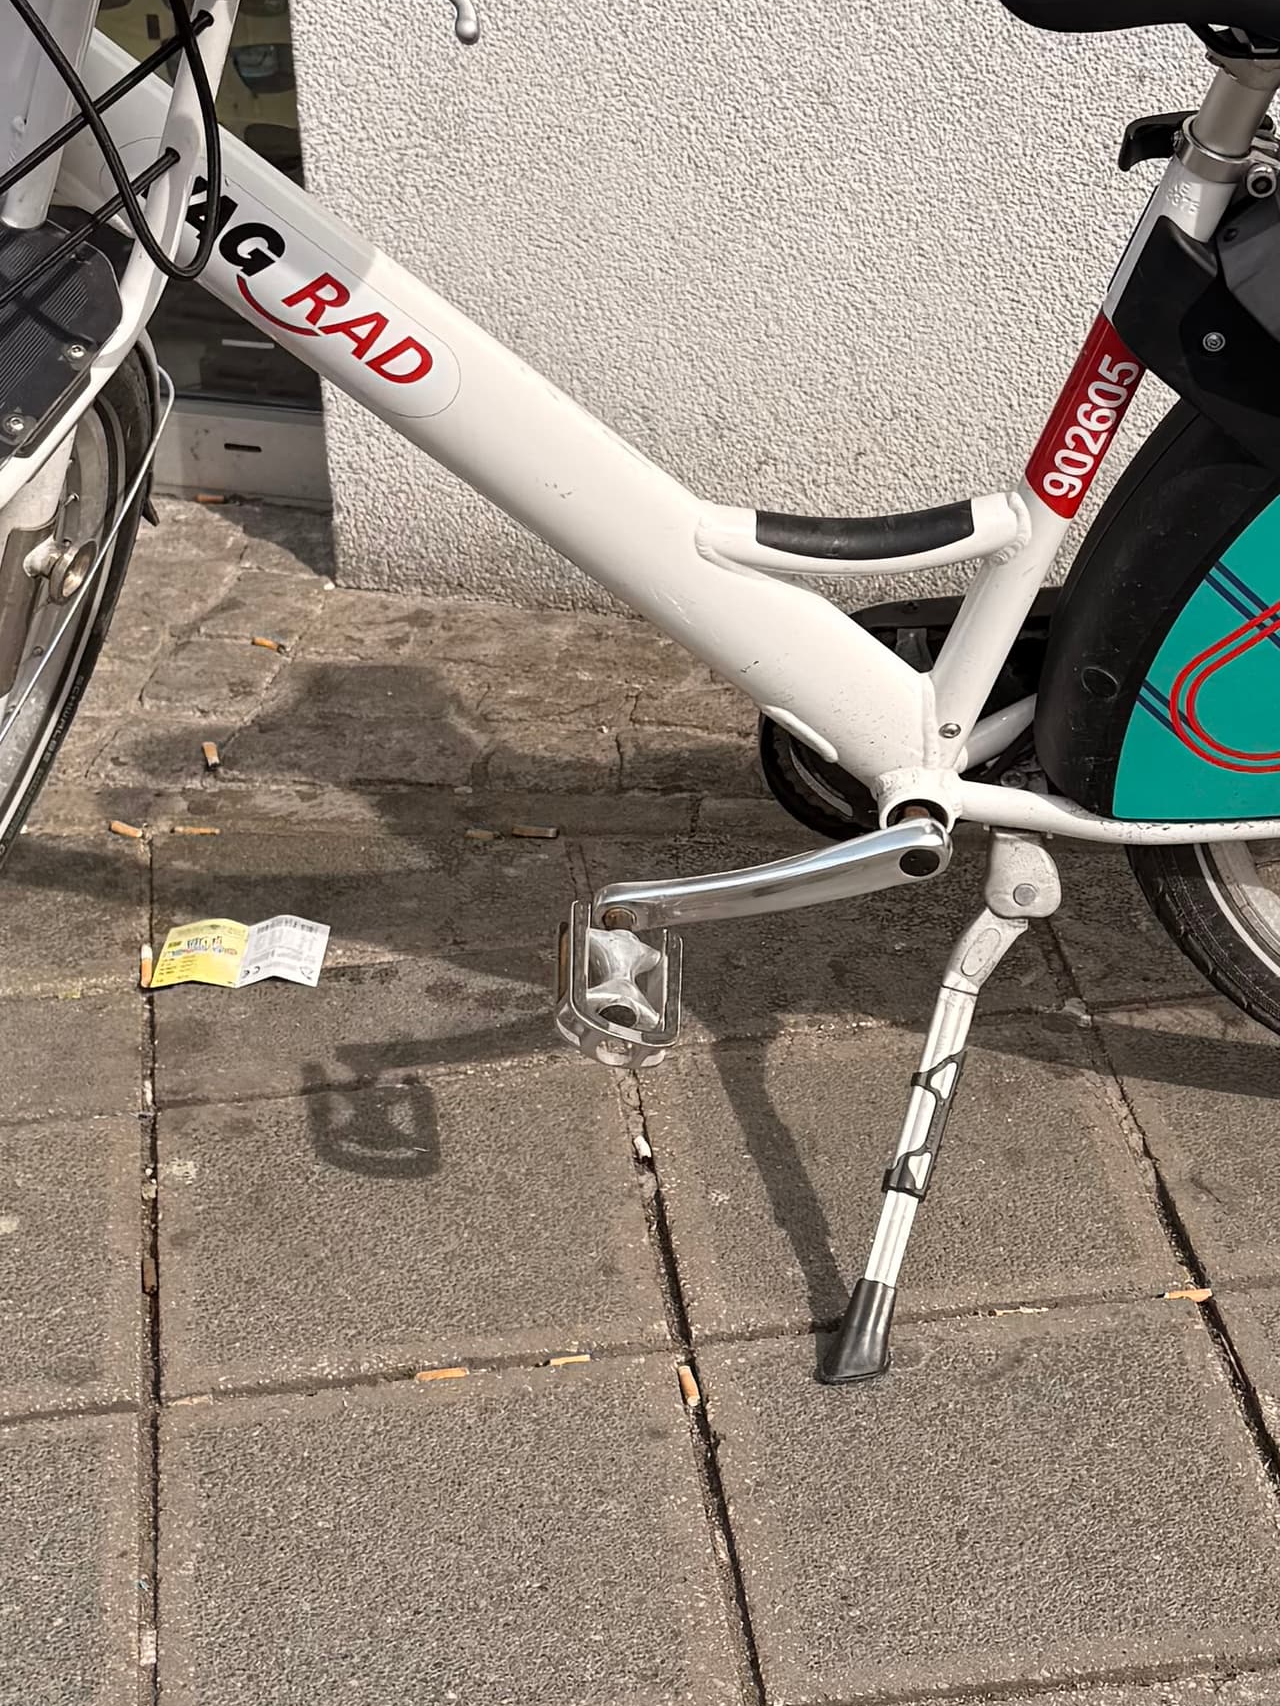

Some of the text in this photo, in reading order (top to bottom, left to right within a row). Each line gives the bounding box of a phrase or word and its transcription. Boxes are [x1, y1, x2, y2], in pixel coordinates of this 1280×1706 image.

[185, 175, 434, 384] AG RAD
[1042, 354, 1140, 499] 902605
